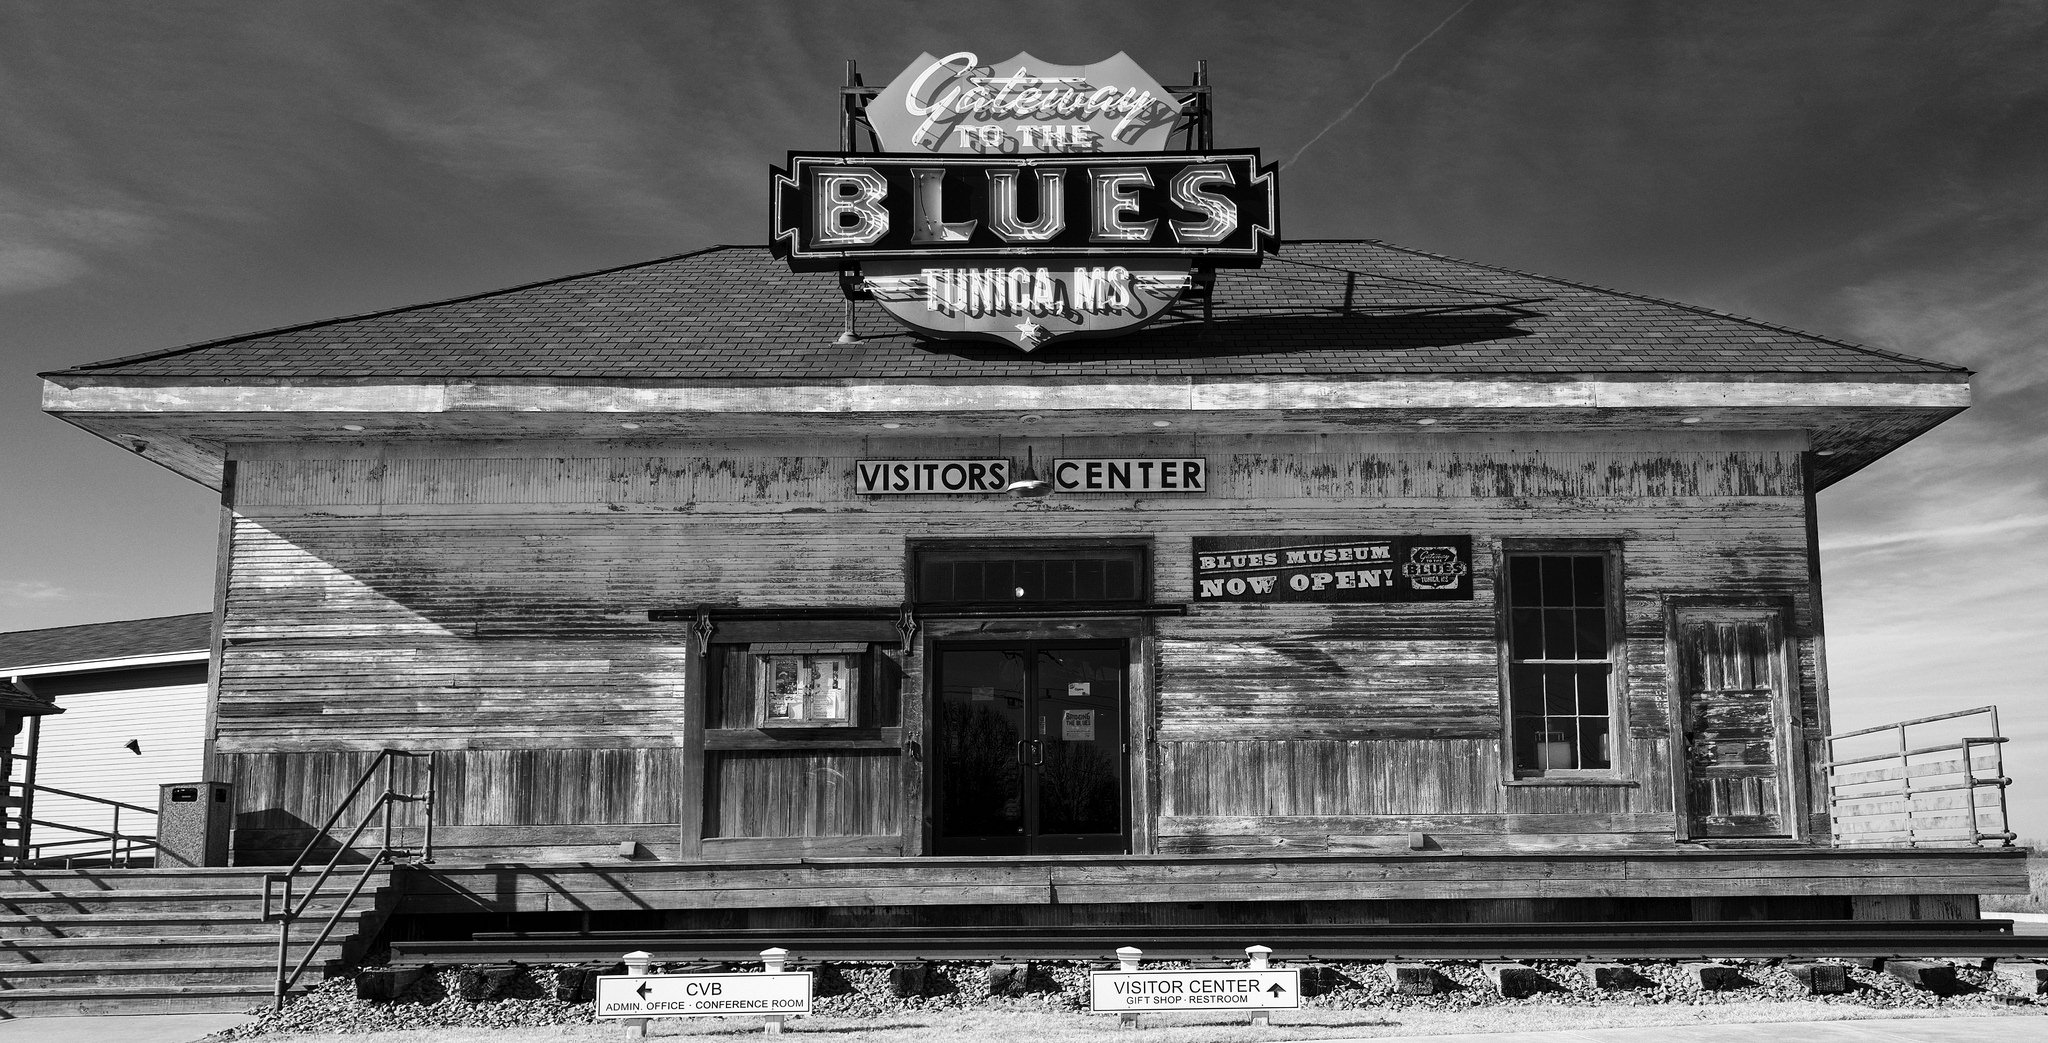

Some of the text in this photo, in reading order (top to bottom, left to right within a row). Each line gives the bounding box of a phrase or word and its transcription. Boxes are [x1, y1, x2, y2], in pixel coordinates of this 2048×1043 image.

[905, 51, 1158, 147] Gateway
[954, 124, 1092, 148] TO THE
[809, 164, 1238, 244] BLUES
[921, 266, 1129, 315] TUNICA, MS
[858, 461, 1202, 491] VISITORS CENTER
[1200, 545, 1390, 570] BLUES MUSEUM
[1408, 564, 1463, 575] BLUES
[1200, 569, 1393, 598] NOW OPEN!
[686, 982, 722, 996] CVB
[1114, 979, 1261, 994] VISITOR CENTER
[606, 999, 804, 1011] ADMIN. OFFICE CONFERENCE ROOM
[1126, 995, 1248, 1005] GIFT SHOP RESTROOM
